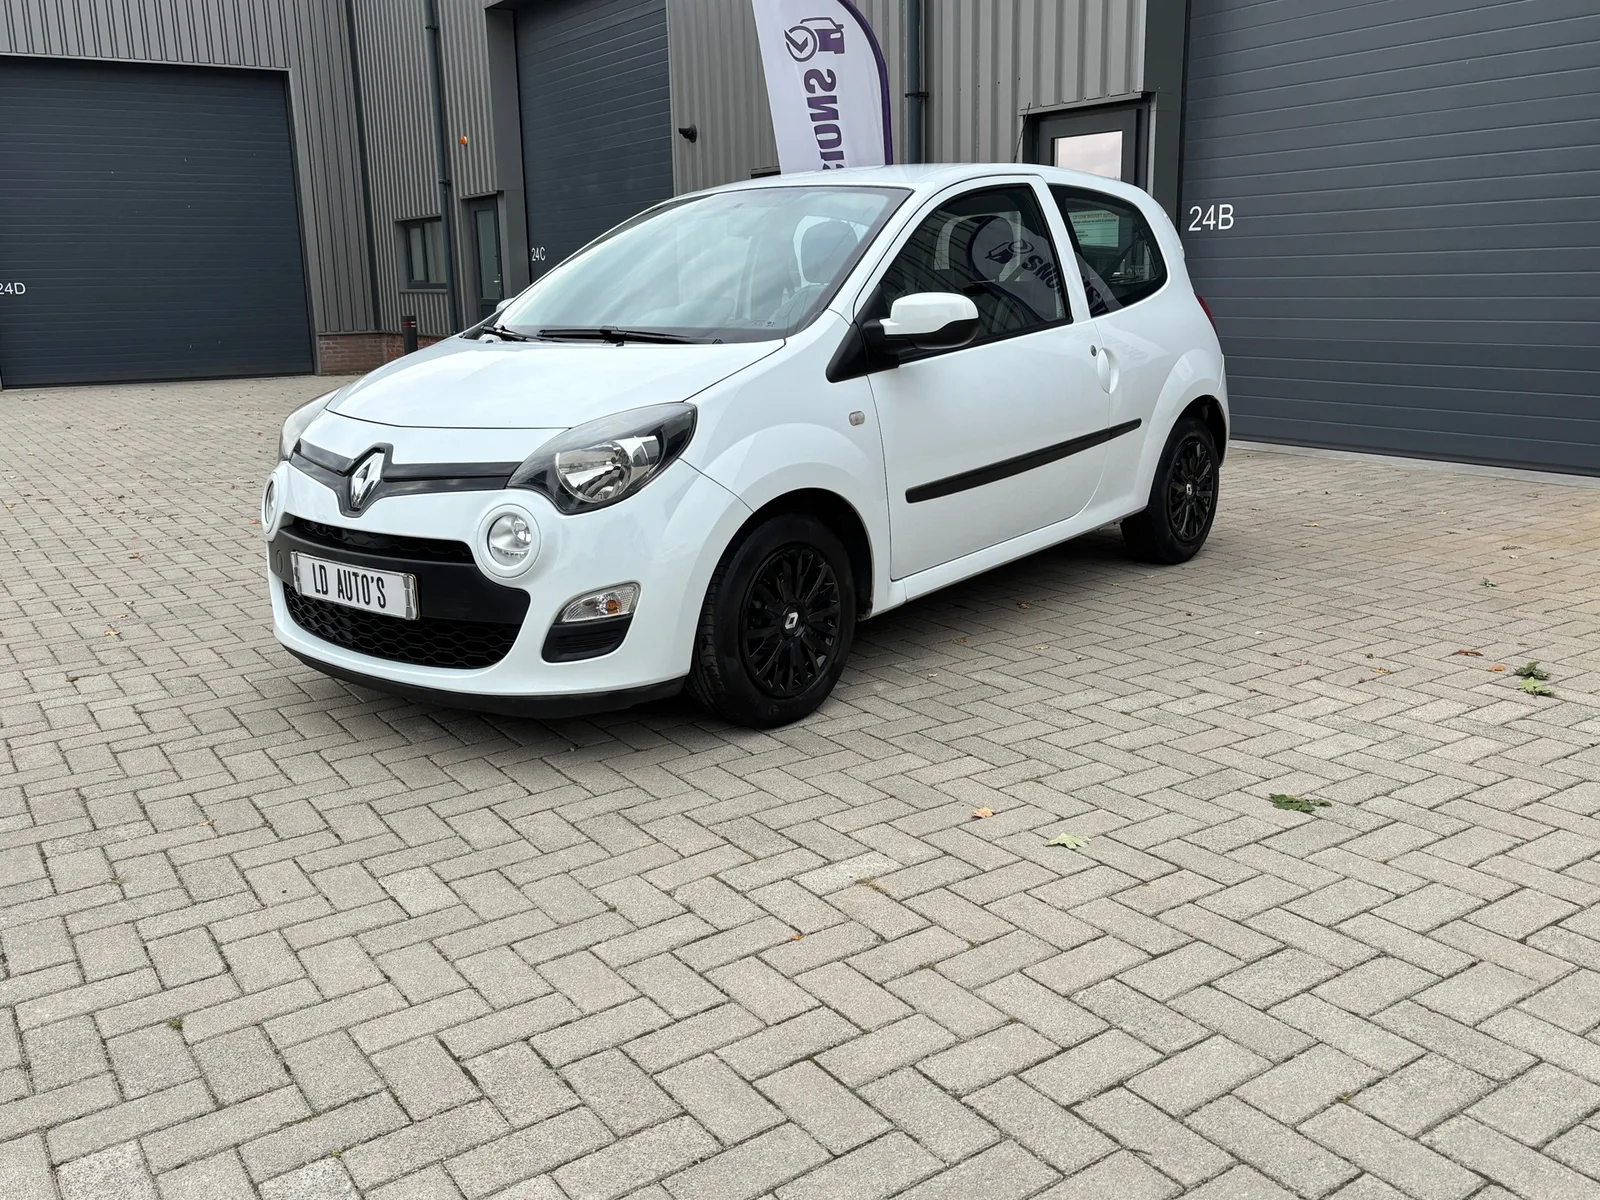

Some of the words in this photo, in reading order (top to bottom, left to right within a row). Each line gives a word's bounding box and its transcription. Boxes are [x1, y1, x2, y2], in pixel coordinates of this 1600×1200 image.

[1188, 204, 1234, 232] 24B
[531, 246, 546, 262] 24C
[312, 562, 329, 596] LD
[337, 568, 387, 609] AUTO'S
